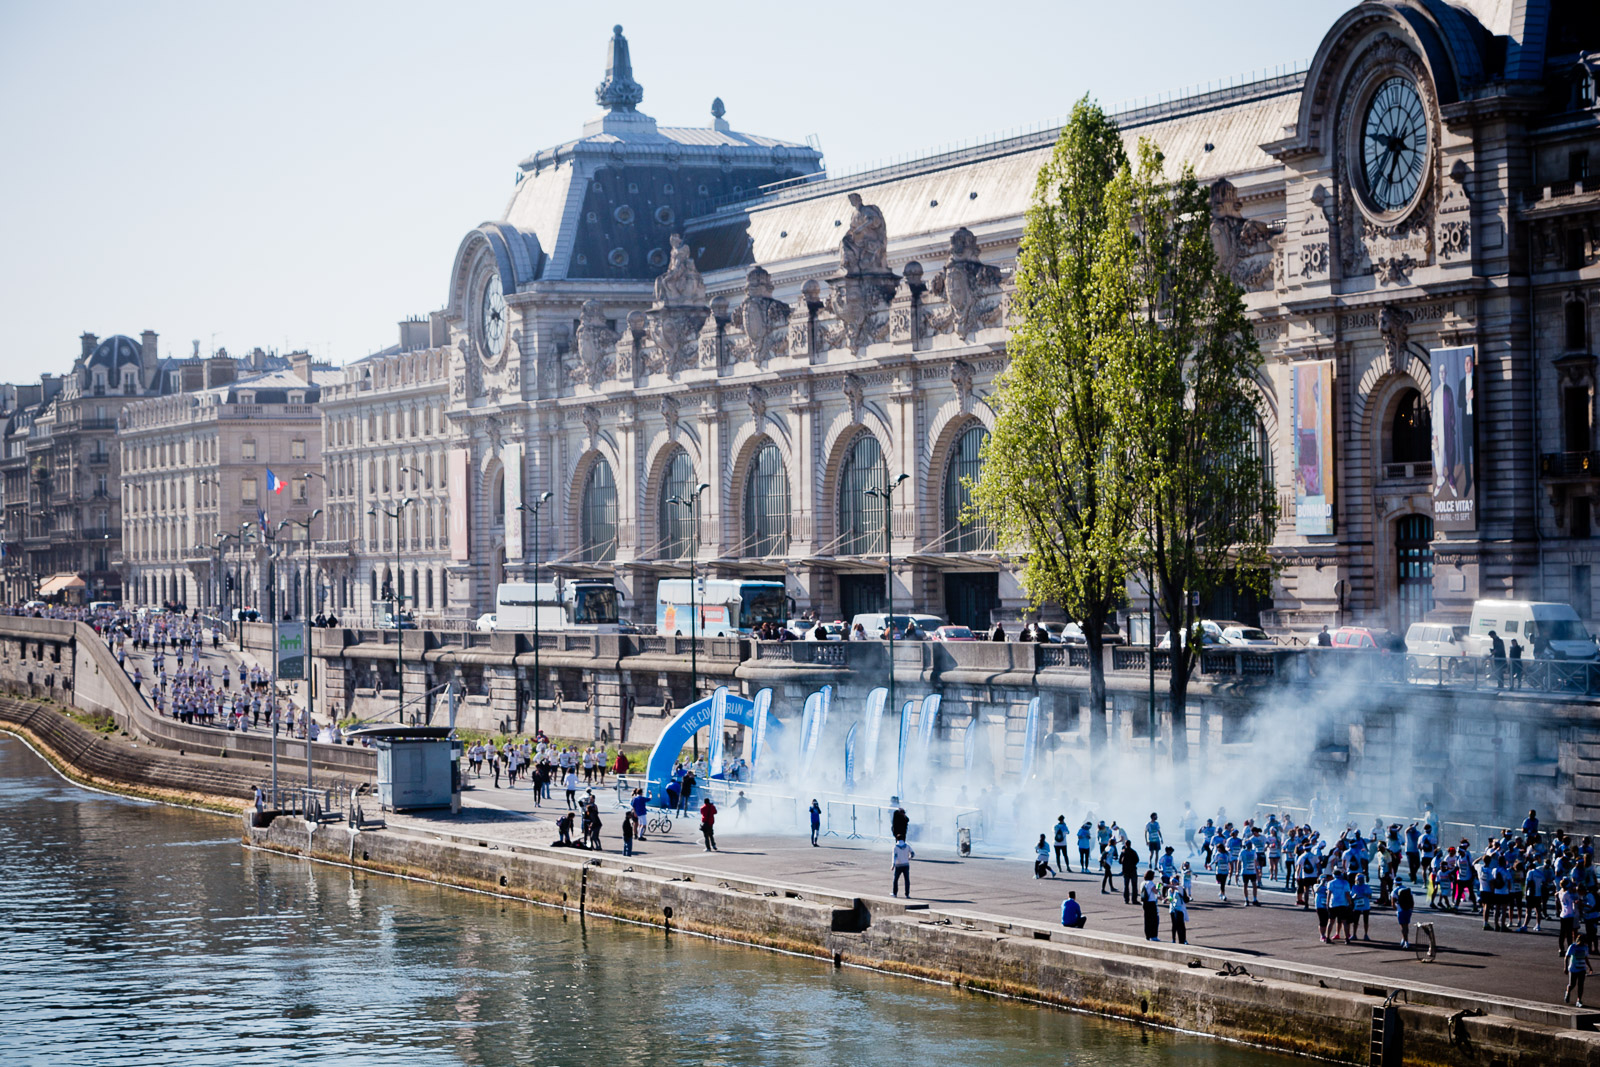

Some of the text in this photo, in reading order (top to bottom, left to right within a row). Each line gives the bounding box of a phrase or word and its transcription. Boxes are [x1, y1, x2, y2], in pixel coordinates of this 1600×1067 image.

[1441, 228, 1461, 246] PO
[1302, 250, 1321, 267] PO
[1413, 305, 1441, 320] TOURS
[923, 366, 949, 379] NANTES
[1434, 499, 1474, 513] DOLCE VITA?
[682, 716, 698, 733] THE
[726, 703, 743, 715] RUN
